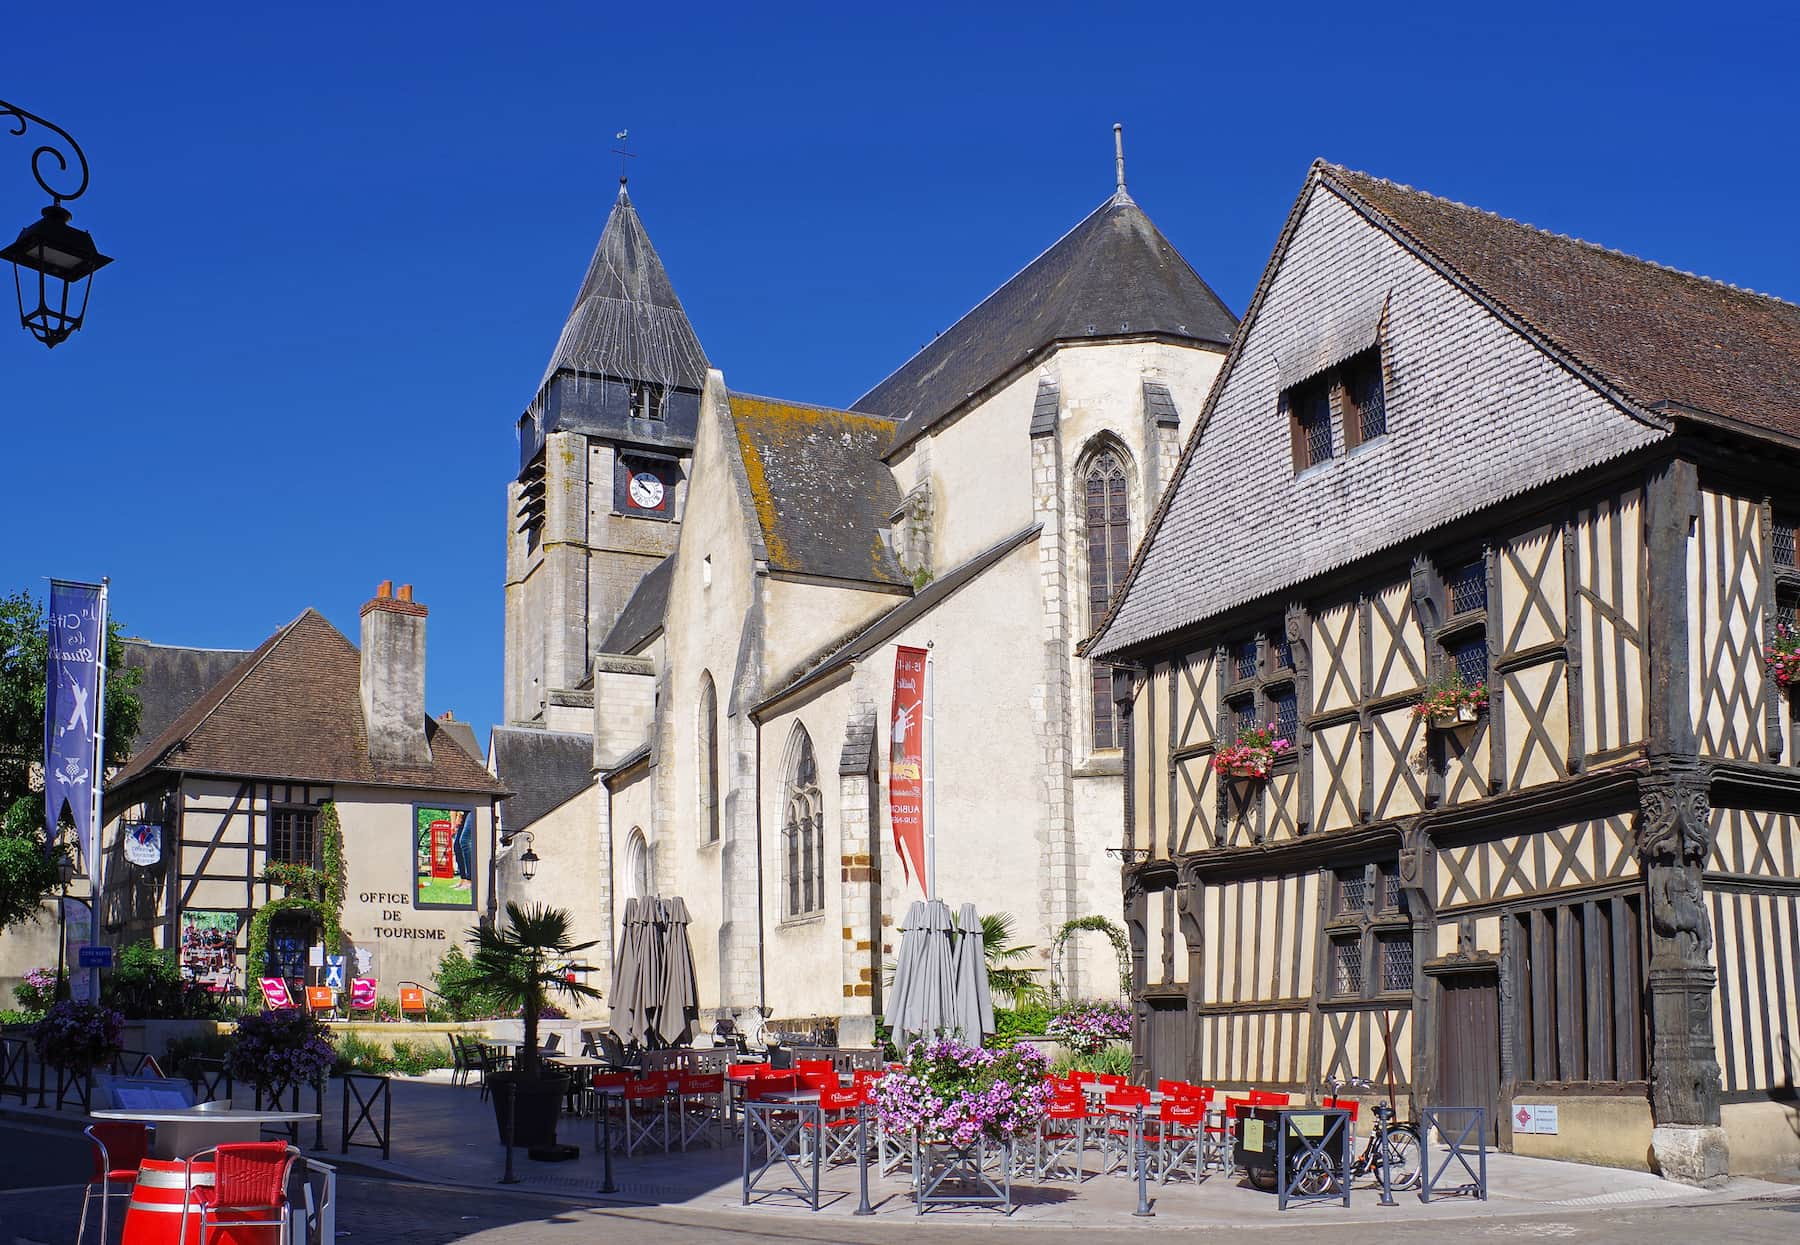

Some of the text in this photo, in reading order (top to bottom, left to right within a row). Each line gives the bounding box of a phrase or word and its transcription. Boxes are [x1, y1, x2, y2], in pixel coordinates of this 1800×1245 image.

[359, 892, 409, 904] OFFICE
[383, 910, 402, 921] DE
[373, 927, 447, 940] TOURISME
